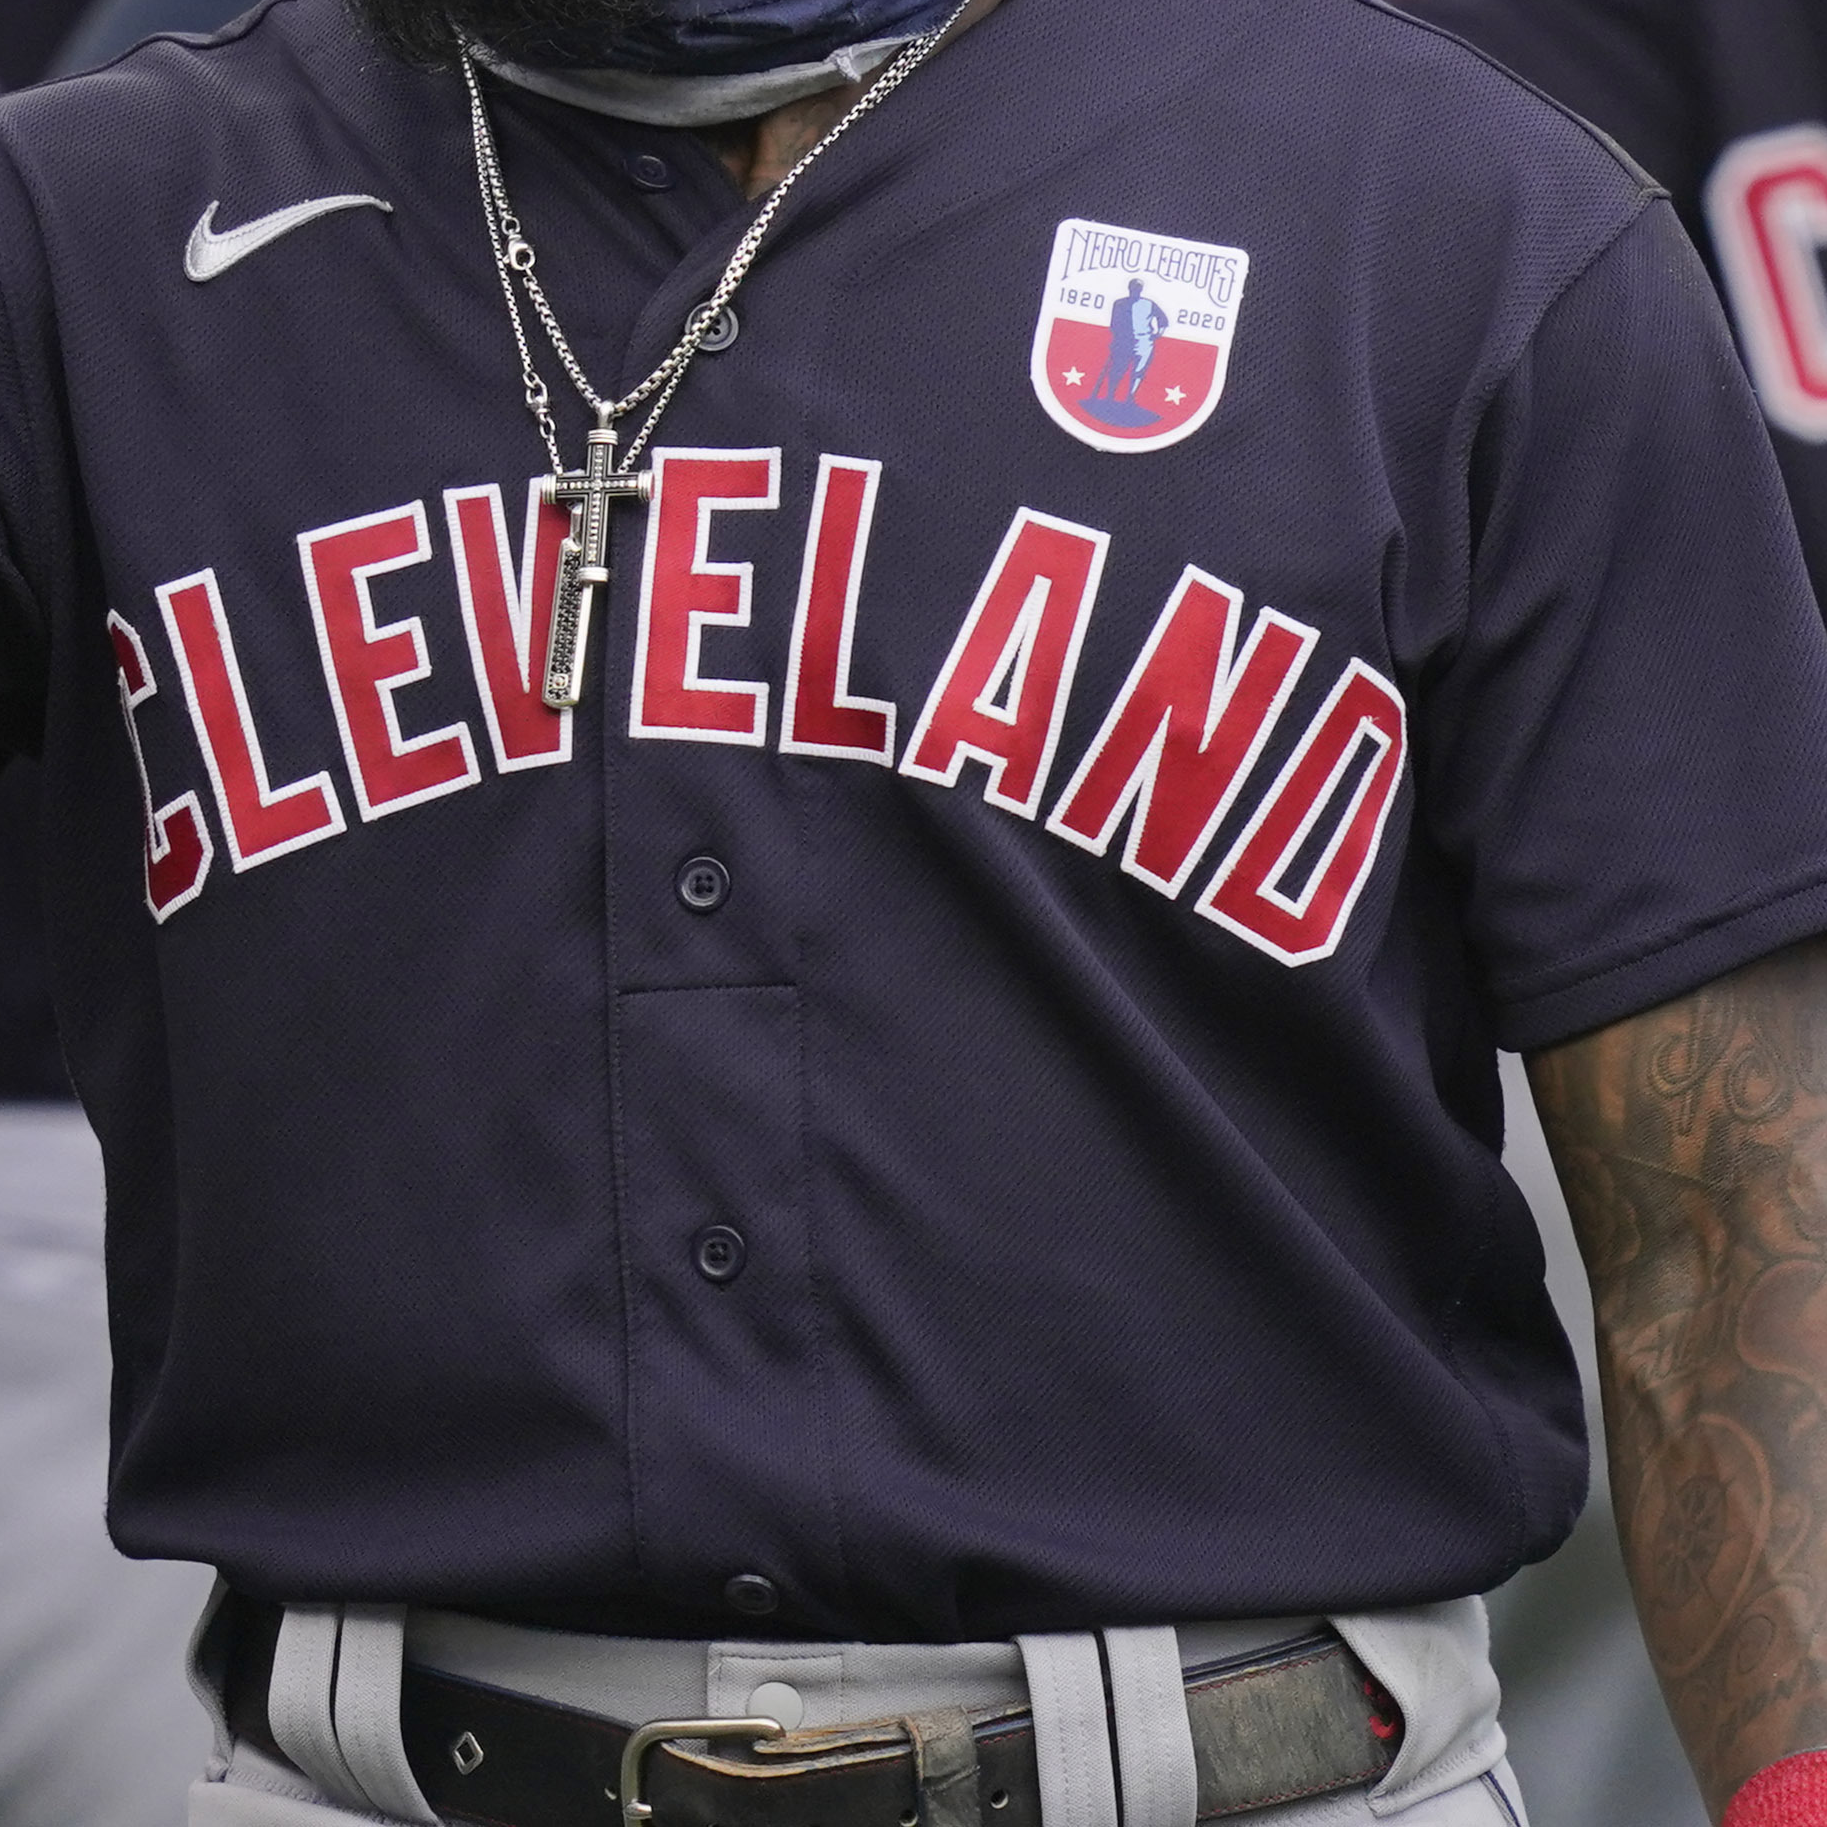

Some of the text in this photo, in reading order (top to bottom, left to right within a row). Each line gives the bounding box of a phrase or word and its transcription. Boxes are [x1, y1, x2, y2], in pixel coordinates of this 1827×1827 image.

[1061, 228, 1238, 308] NEGRO LEAGUES
[1059, 287, 1225, 332] 1920 2020
